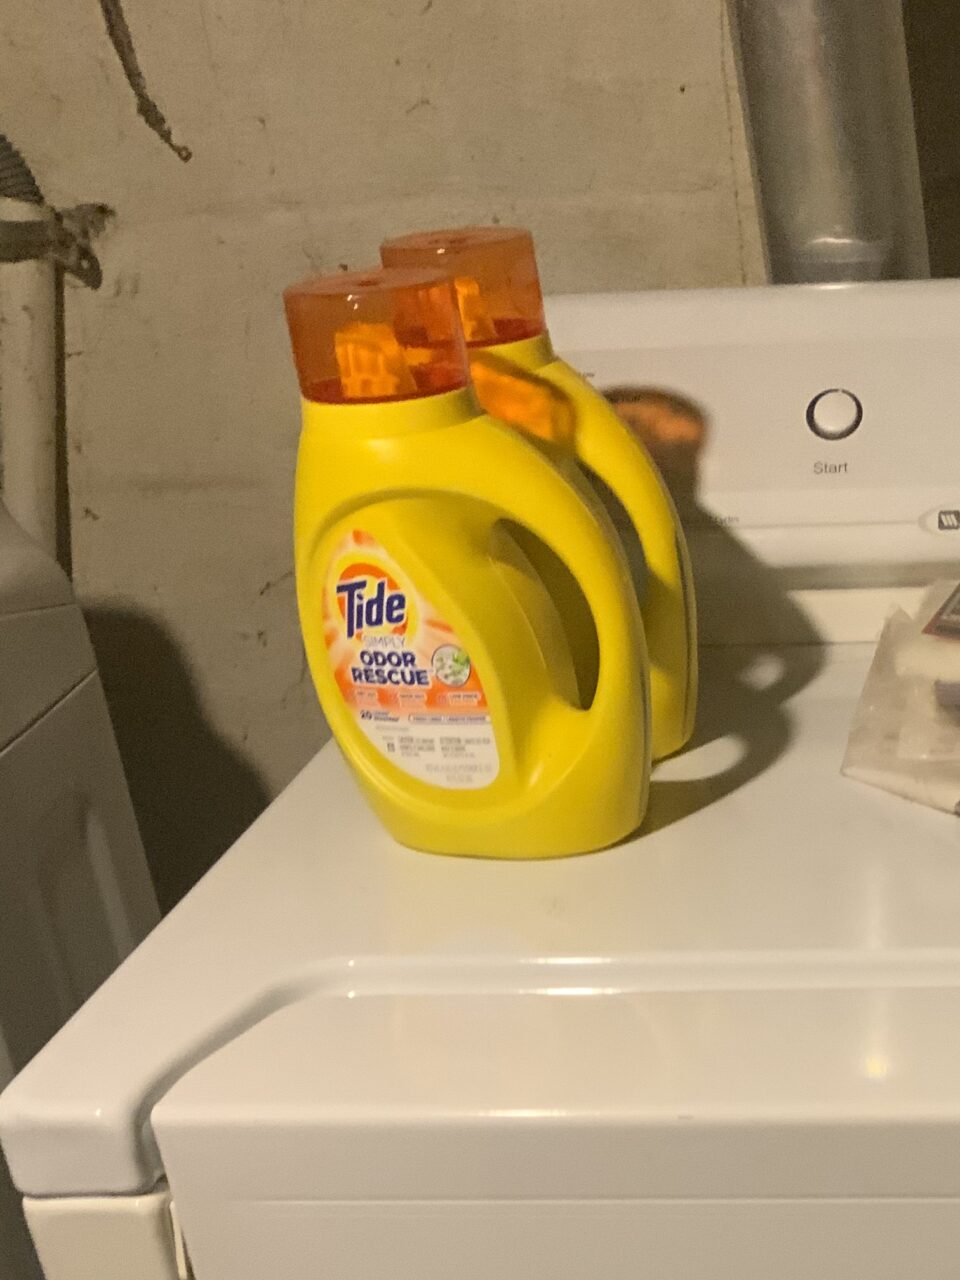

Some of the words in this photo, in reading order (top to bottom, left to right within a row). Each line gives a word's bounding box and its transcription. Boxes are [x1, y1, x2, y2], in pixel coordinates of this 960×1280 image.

[813, 462, 848, 474] Start
[336, 580, 406, 639] Tide
[363, 635, 406, 648] SIMPLY
[359, 650, 416, 668] ODOR
[351, 667, 430, 686] RESCUE
